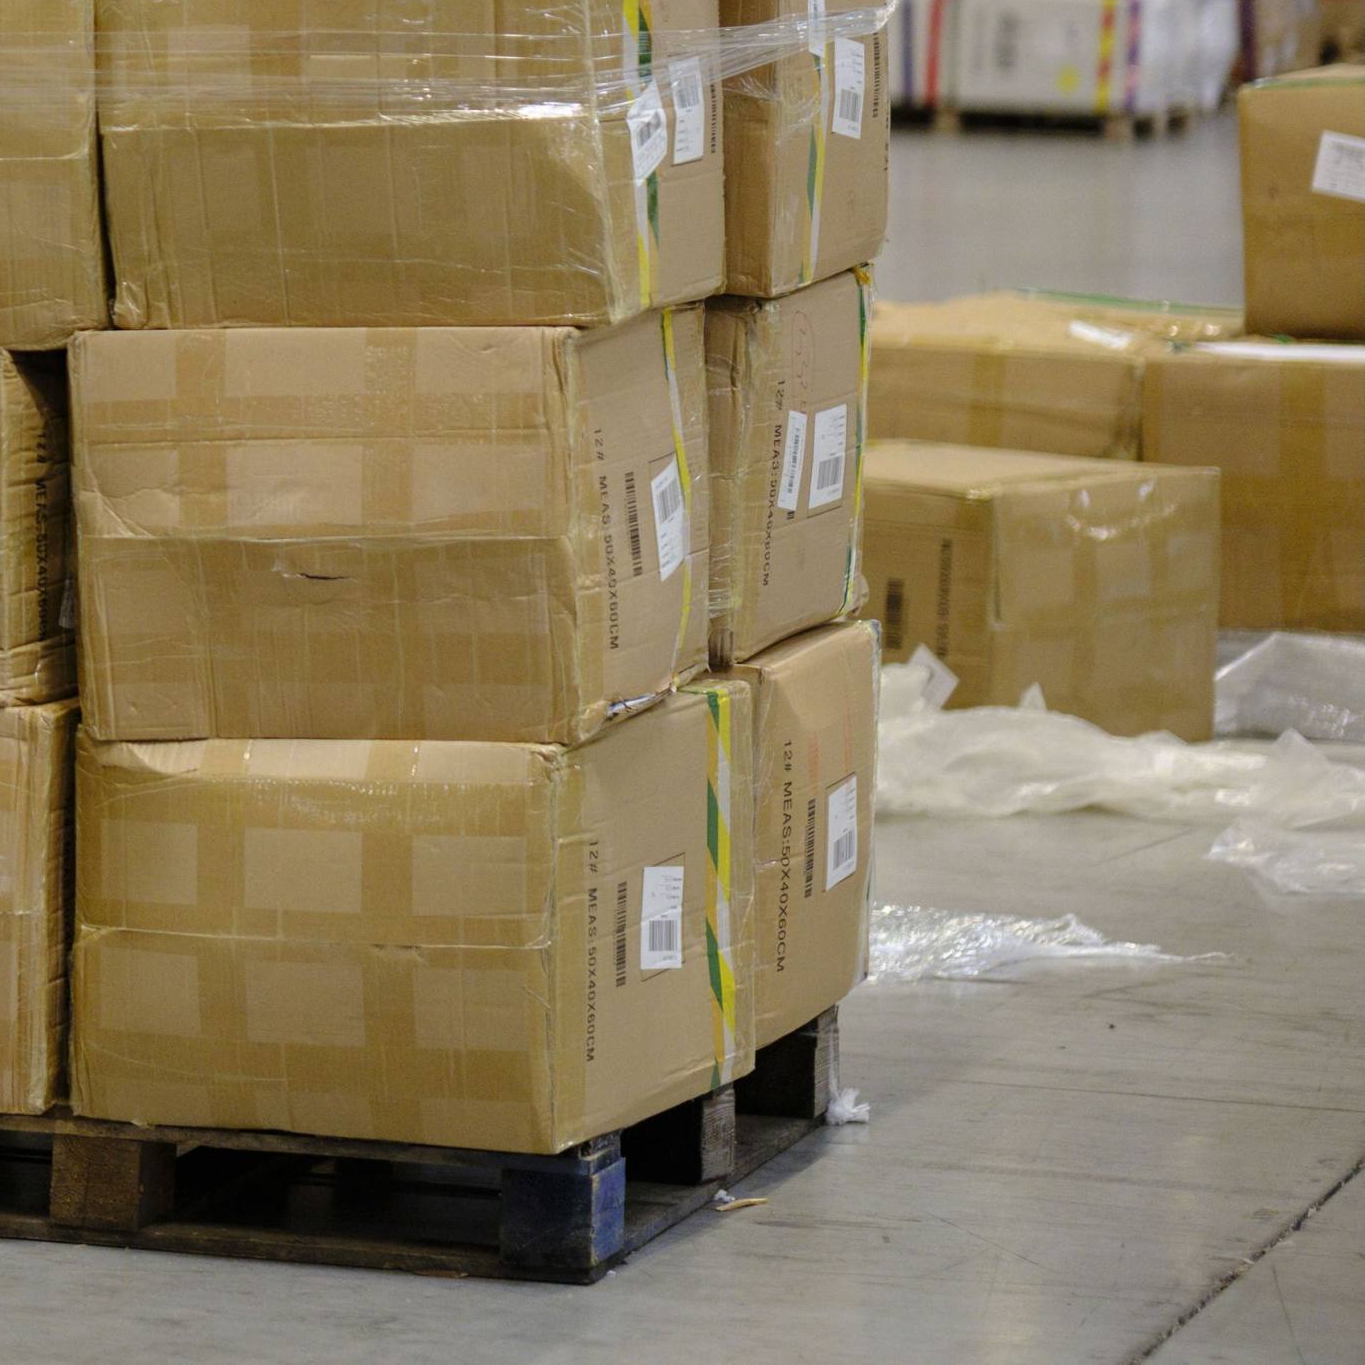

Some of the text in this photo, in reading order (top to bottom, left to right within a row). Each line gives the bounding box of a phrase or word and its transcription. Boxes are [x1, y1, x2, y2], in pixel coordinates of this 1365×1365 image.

[586, 840, 599, 1064] 12# MEAS:50X40X60CM
[776, 739, 793, 973] 12# MEAS:50X40X60CM
